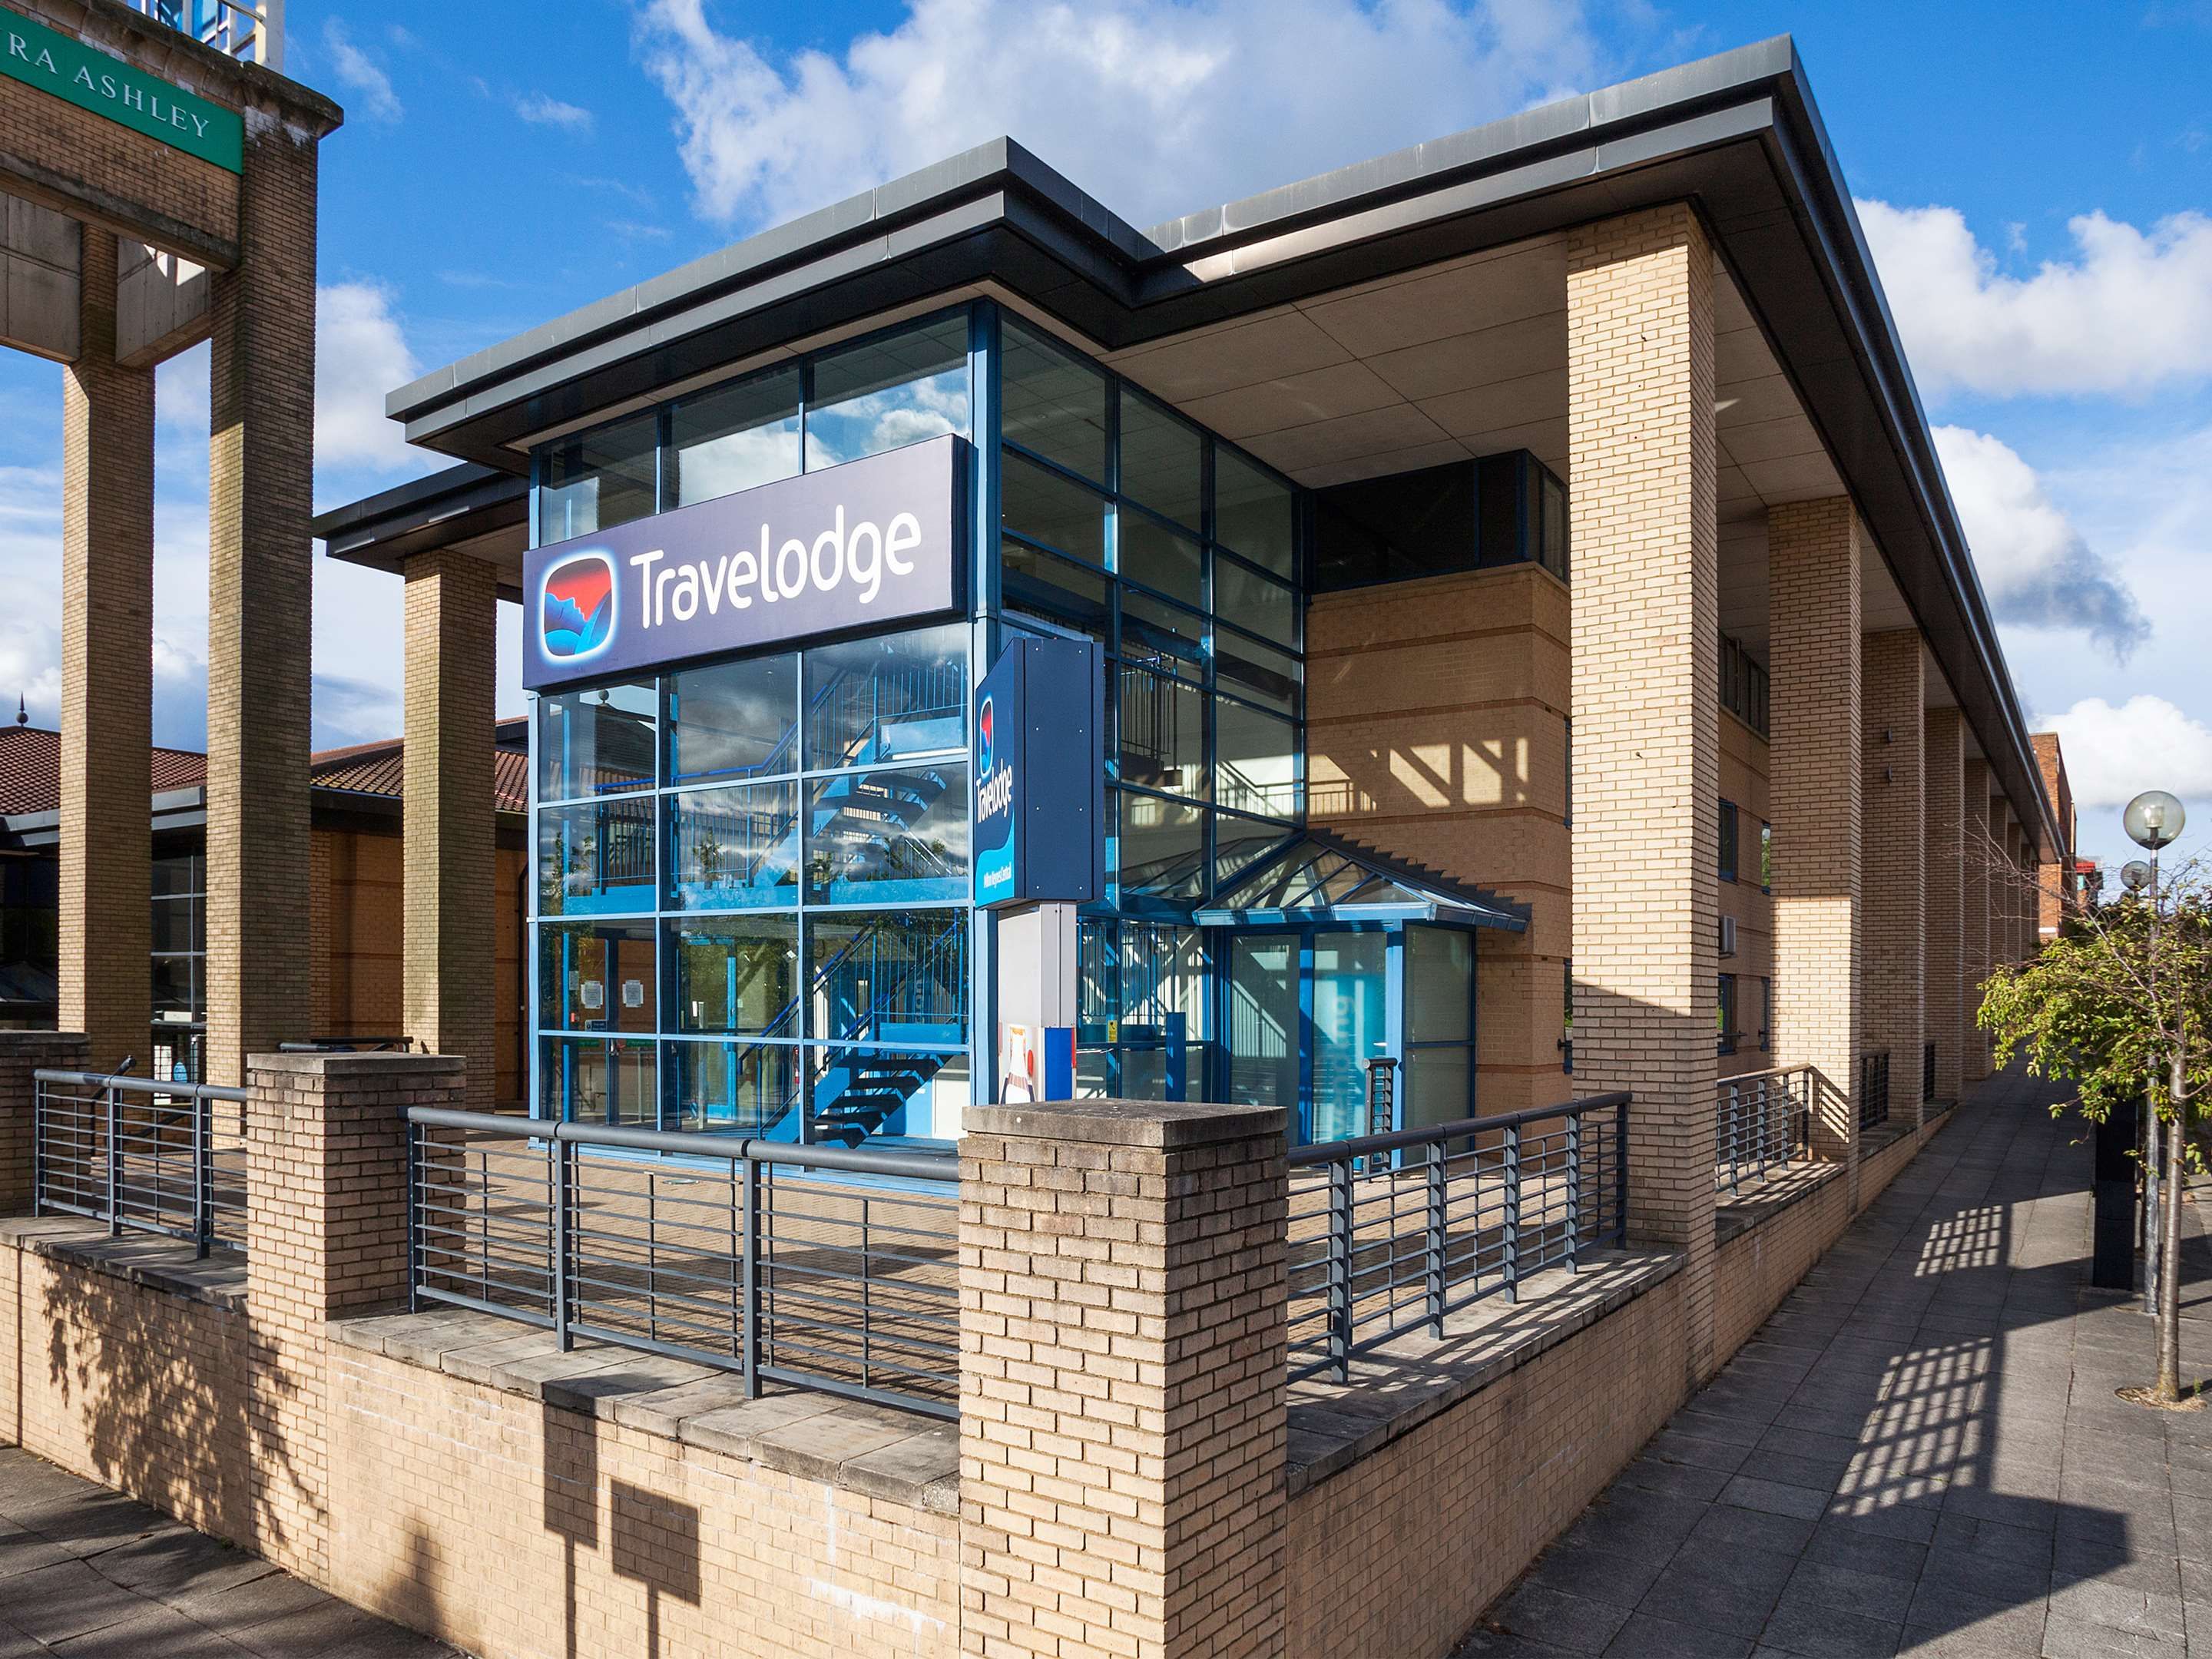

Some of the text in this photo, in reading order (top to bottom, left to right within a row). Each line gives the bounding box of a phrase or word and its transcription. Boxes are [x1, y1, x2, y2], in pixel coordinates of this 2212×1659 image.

[0, 28, 210, 138] RA ASHLEY
[630, 505, 922, 629] Travelodge
[976, 757, 1012, 824] Travelodge
